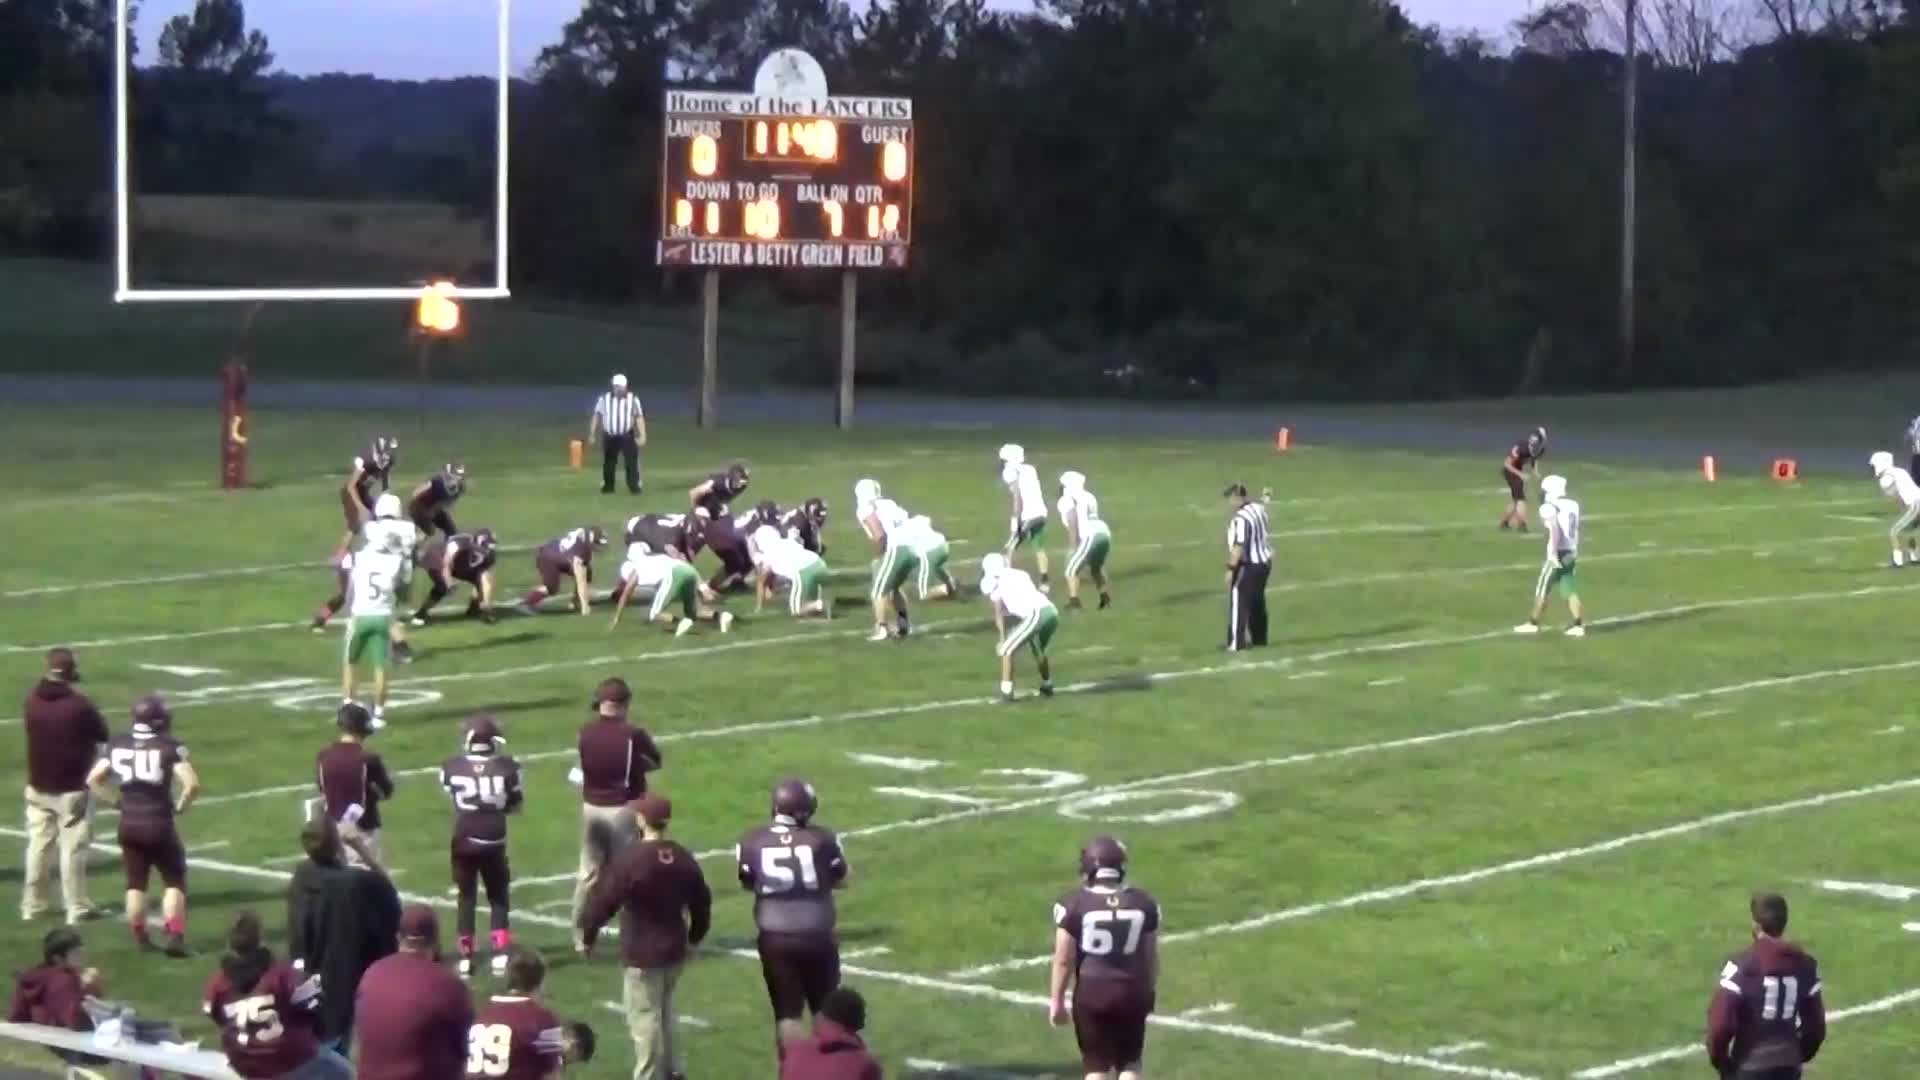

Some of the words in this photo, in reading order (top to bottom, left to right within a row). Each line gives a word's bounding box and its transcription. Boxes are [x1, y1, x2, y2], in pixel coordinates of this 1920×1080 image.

[671, 93, 733, 113] Home
[740, 96, 762, 113] of
[769, 97, 804, 114] the
[811, 98, 908, 118] LANCERS
[668, 119, 722, 139] LANCERS
[861, 125, 907, 144] GUEST
[686, 181, 731, 200] DOWN
[736, 182, 756, 200] TO
[758, 182, 779, 201] GO
[797, 184, 826, 203] BALL
[830, 185, 848, 203] ON
[855, 185, 883, 204] QTR
[823, 199, 843, 237] 7
[691, 241, 740, 265] LESTER
[743, 242, 755, 265] &
[757, 242, 799, 266] BETTY
[801, 242, 843, 266] GREEN
[847, 243, 883, 267] FIELD
[368, 571, 382, 601] 5
[111, 747, 163, 784] 54
[449, 774, 507, 811] 24
[761, 845, 818, 894] 51
[1081, 908, 1145, 955] 67
[1761, 975, 1798, 1020] 11
[223, 994, 284, 1046] 75
